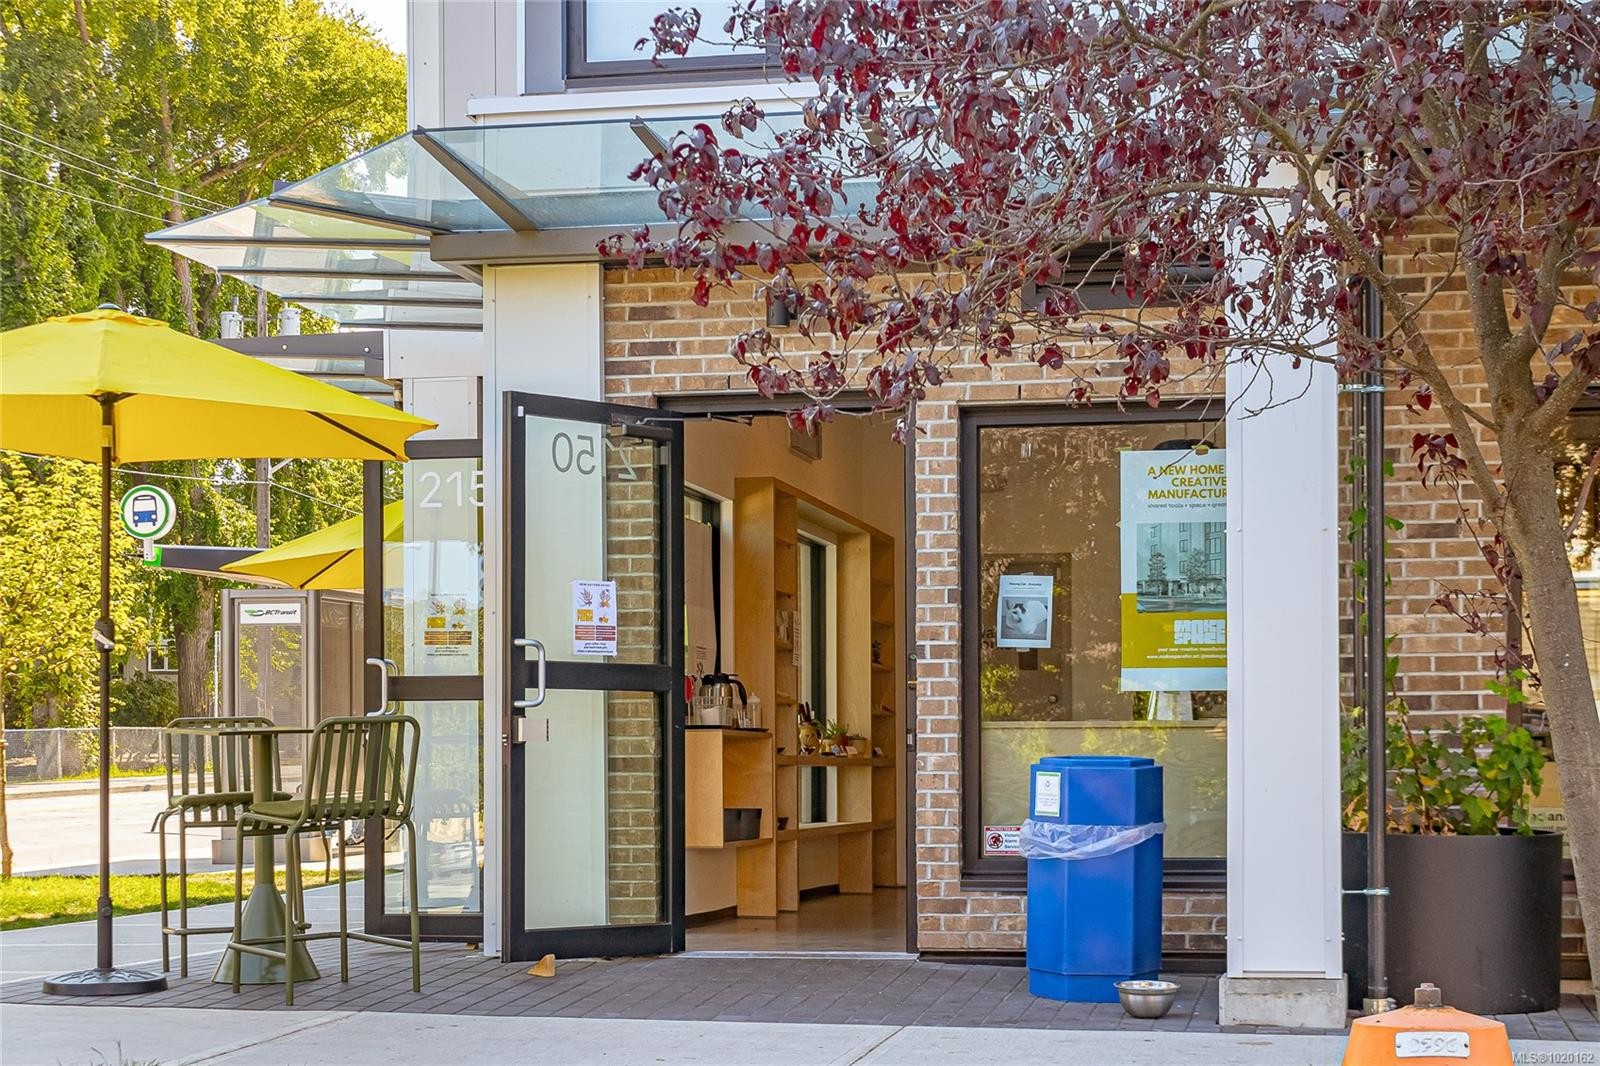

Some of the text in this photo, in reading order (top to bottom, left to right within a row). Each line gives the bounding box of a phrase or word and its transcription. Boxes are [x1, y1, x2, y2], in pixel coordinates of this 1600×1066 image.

[1148, 464, 1225, 476] A NEW HOME
[1171, 476, 1227, 487] CREATIVE
